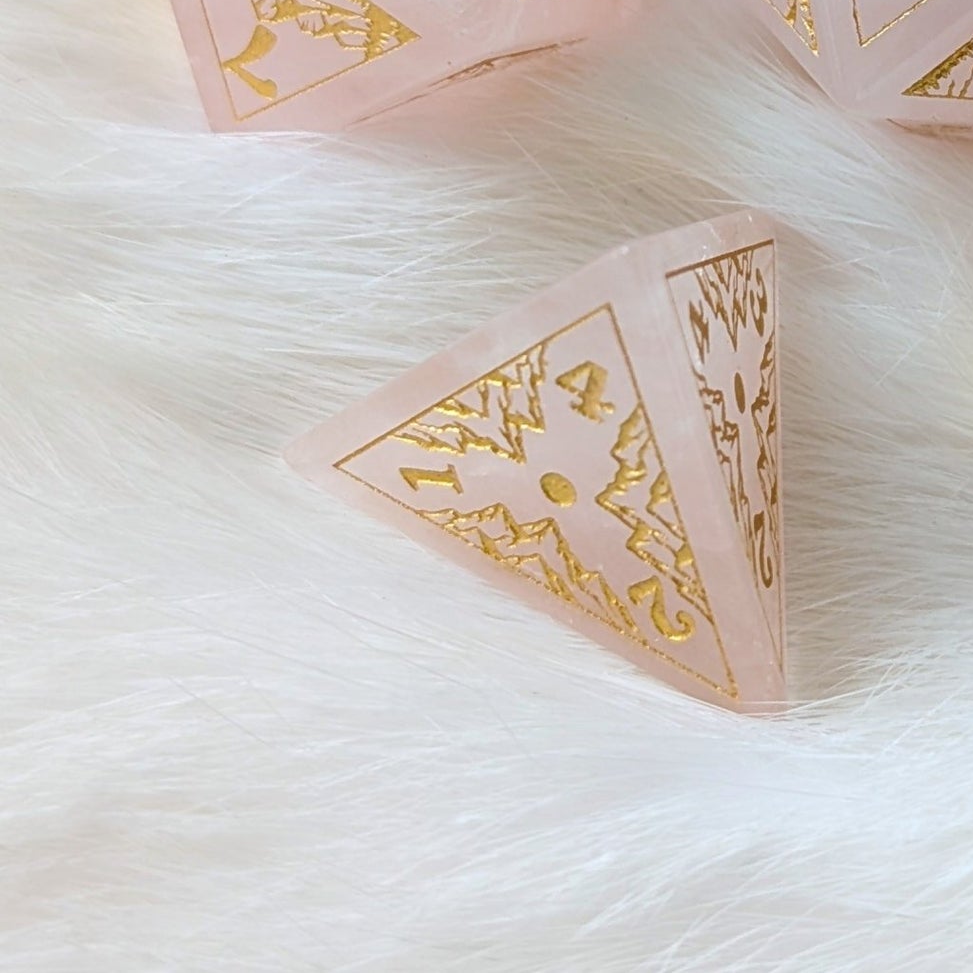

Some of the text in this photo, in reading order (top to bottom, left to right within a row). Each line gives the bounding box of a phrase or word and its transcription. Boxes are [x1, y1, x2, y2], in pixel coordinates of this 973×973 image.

[222, 24, 278, 100] 7
[750, 268, 767, 337] 3
[556, 360, 616, 422] 4
[400, 464, 463, 494] 1
[751, 510, 773, 588] 2
[627, 575, 695, 642] 2
